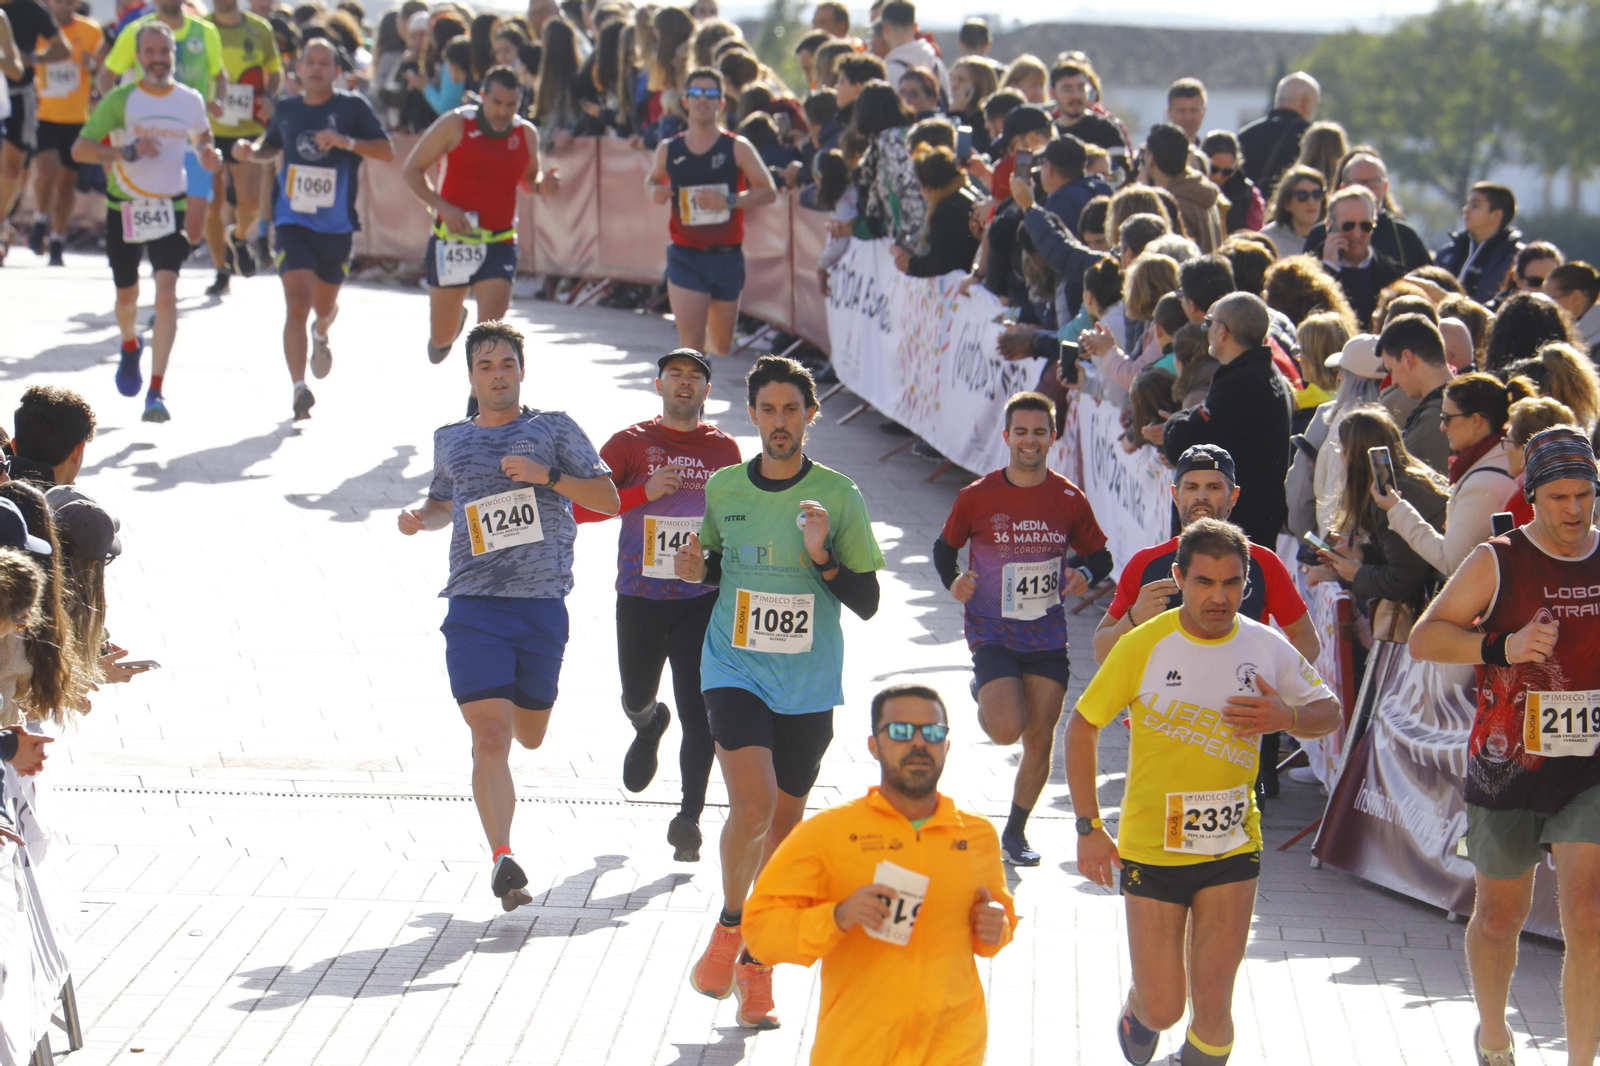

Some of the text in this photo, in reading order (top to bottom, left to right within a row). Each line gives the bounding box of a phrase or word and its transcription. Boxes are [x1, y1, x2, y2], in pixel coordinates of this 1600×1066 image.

[296, 176, 332, 194] 1060
[134, 210, 170, 226] 5641
[667, 455, 705, 468] MEDIA
[485, 495, 512, 508] IMDECO
[481, 503, 535, 534] 1240
[724, 514, 746, 522] PETER
[1012, 520, 1049, 532] MEDIA
[993, 529, 1067, 543] 36 MARATÓN
[722, 540, 813, 568] CAMPILLO
[1016, 571, 1058, 595] 4138
[760, 595, 791, 605] IMDECO
[738, 611, 746, 634] CAJÓN
[751, 607, 809, 634] 1082
[1551, 693, 1585, 701] IMDECO
[1542, 706, 1600, 733] 2119
[1194, 793, 1228, 802] IMDECO
[1184, 802, 1245, 832] 2335
